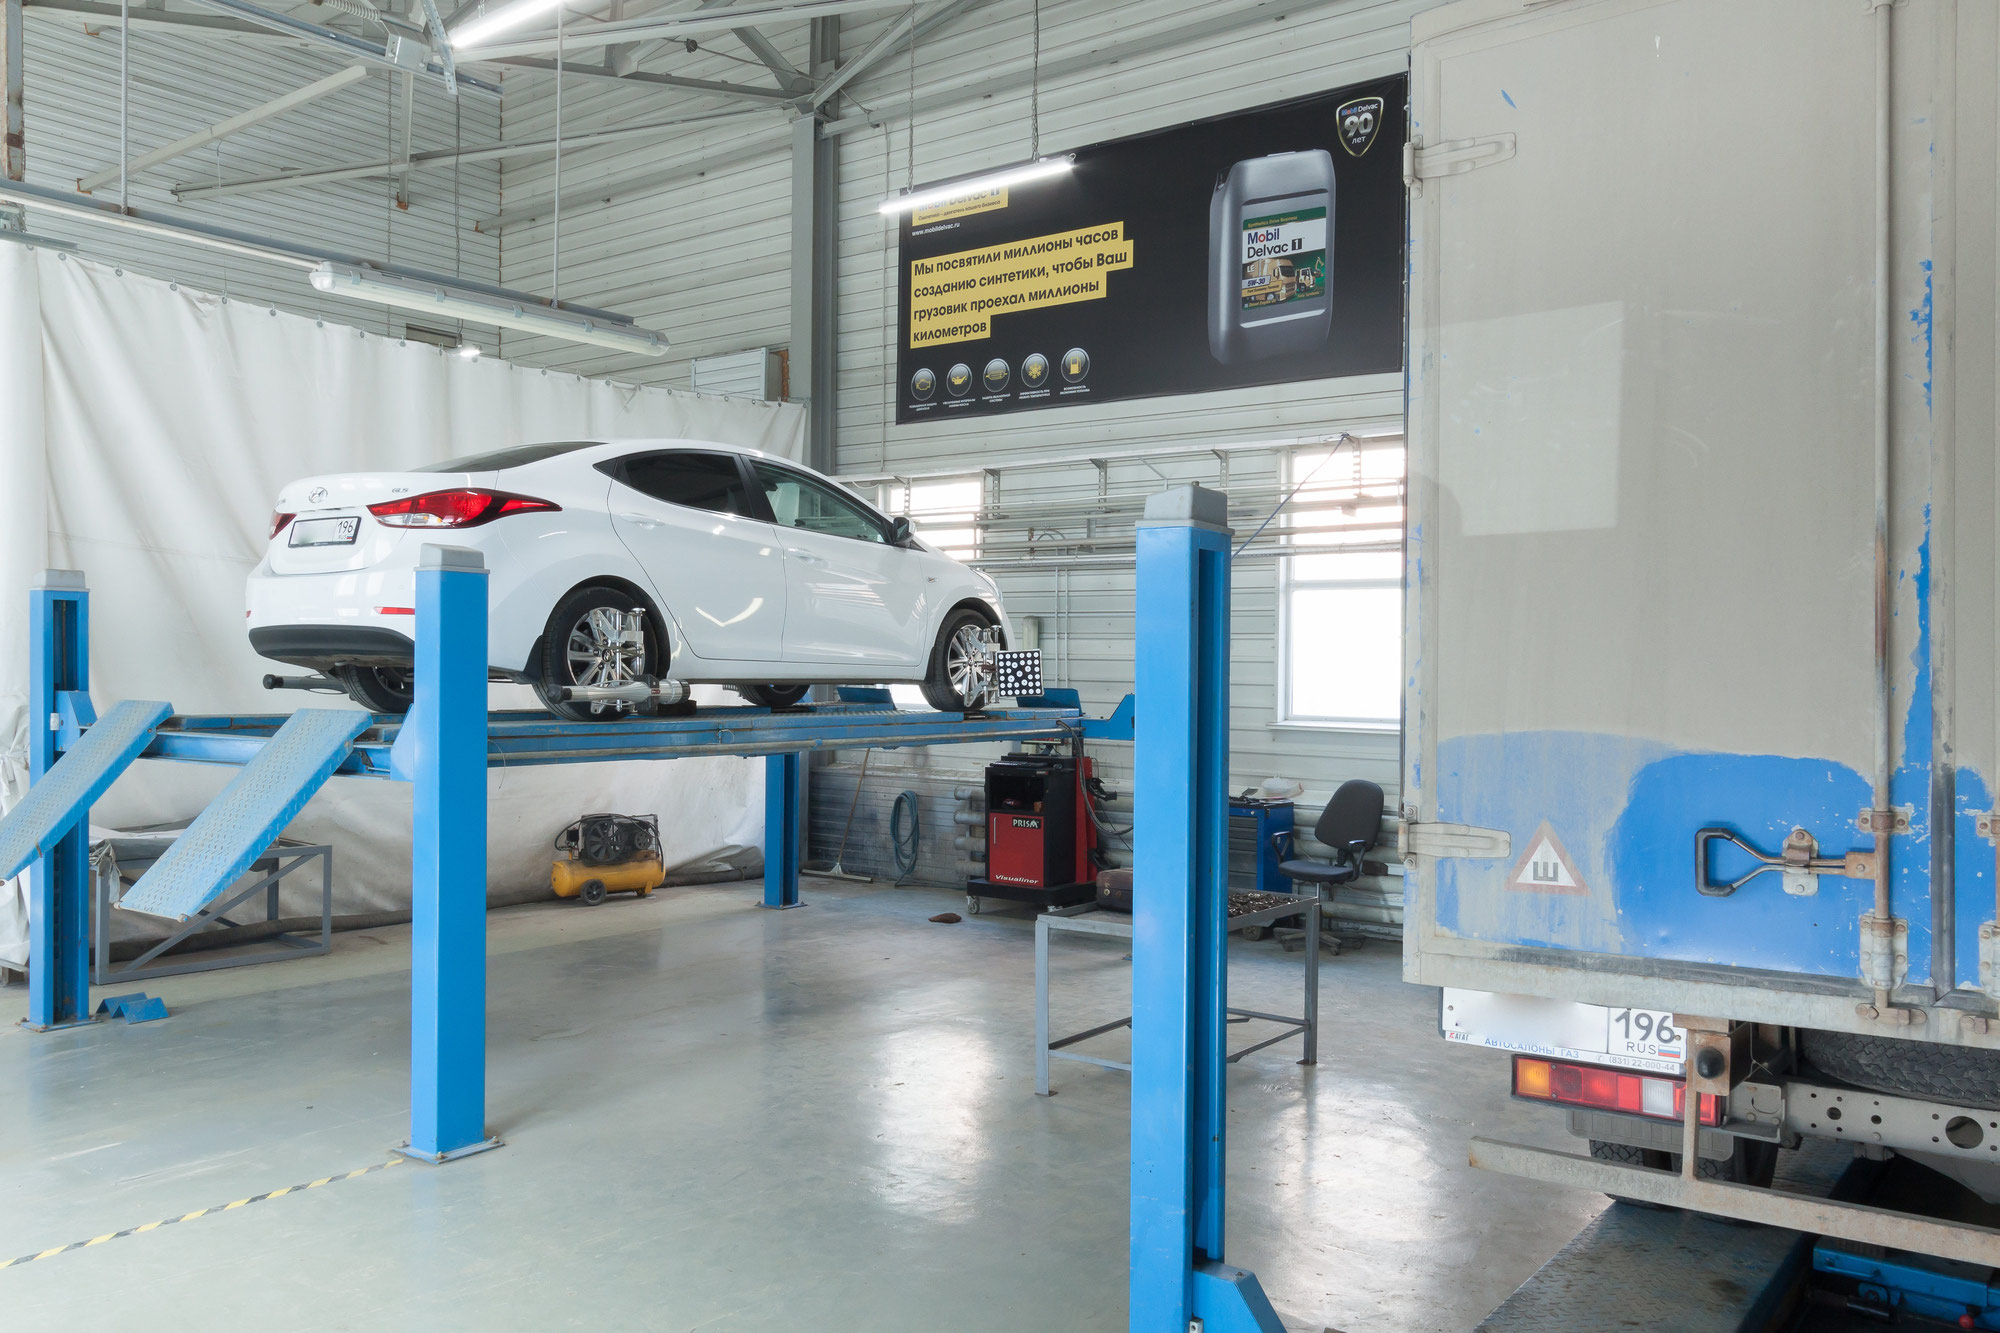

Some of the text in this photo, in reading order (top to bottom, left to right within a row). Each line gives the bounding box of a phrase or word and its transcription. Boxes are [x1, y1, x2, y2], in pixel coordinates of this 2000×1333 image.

[1358, 104, 1378, 112] Delvac
[1344, 112, 1373, 138] 90
[1352, 136, 1366, 144] лет
[1248, 228, 1280, 245] Mobil
[914, 230, 1118, 276] Мы посвятили миллионы часов
[1248, 244, 1288, 258] Delvac
[914, 252, 1127, 298] созданию синтетики, чтобы Ваш
[1248, 278, 1265, 286] 5W-30
[914, 280, 1099, 322] грузовик проехал миллионы
[914, 322, 986, 342] километров
[338, 520, 354, 534] 196
[1012, 819, 1039, 828] PRISM
[995, 874, 1039, 884] Visualiner
[1533, 862, 1558, 882] Ш
[1615, 1011, 1675, 1044] 196
[1561, 1049, 1579, 1059] ГАЗ
[1626, 1042, 1656, 1055] RUS
[1609, 1056, 1675, 1071] (831) 22-000-44
